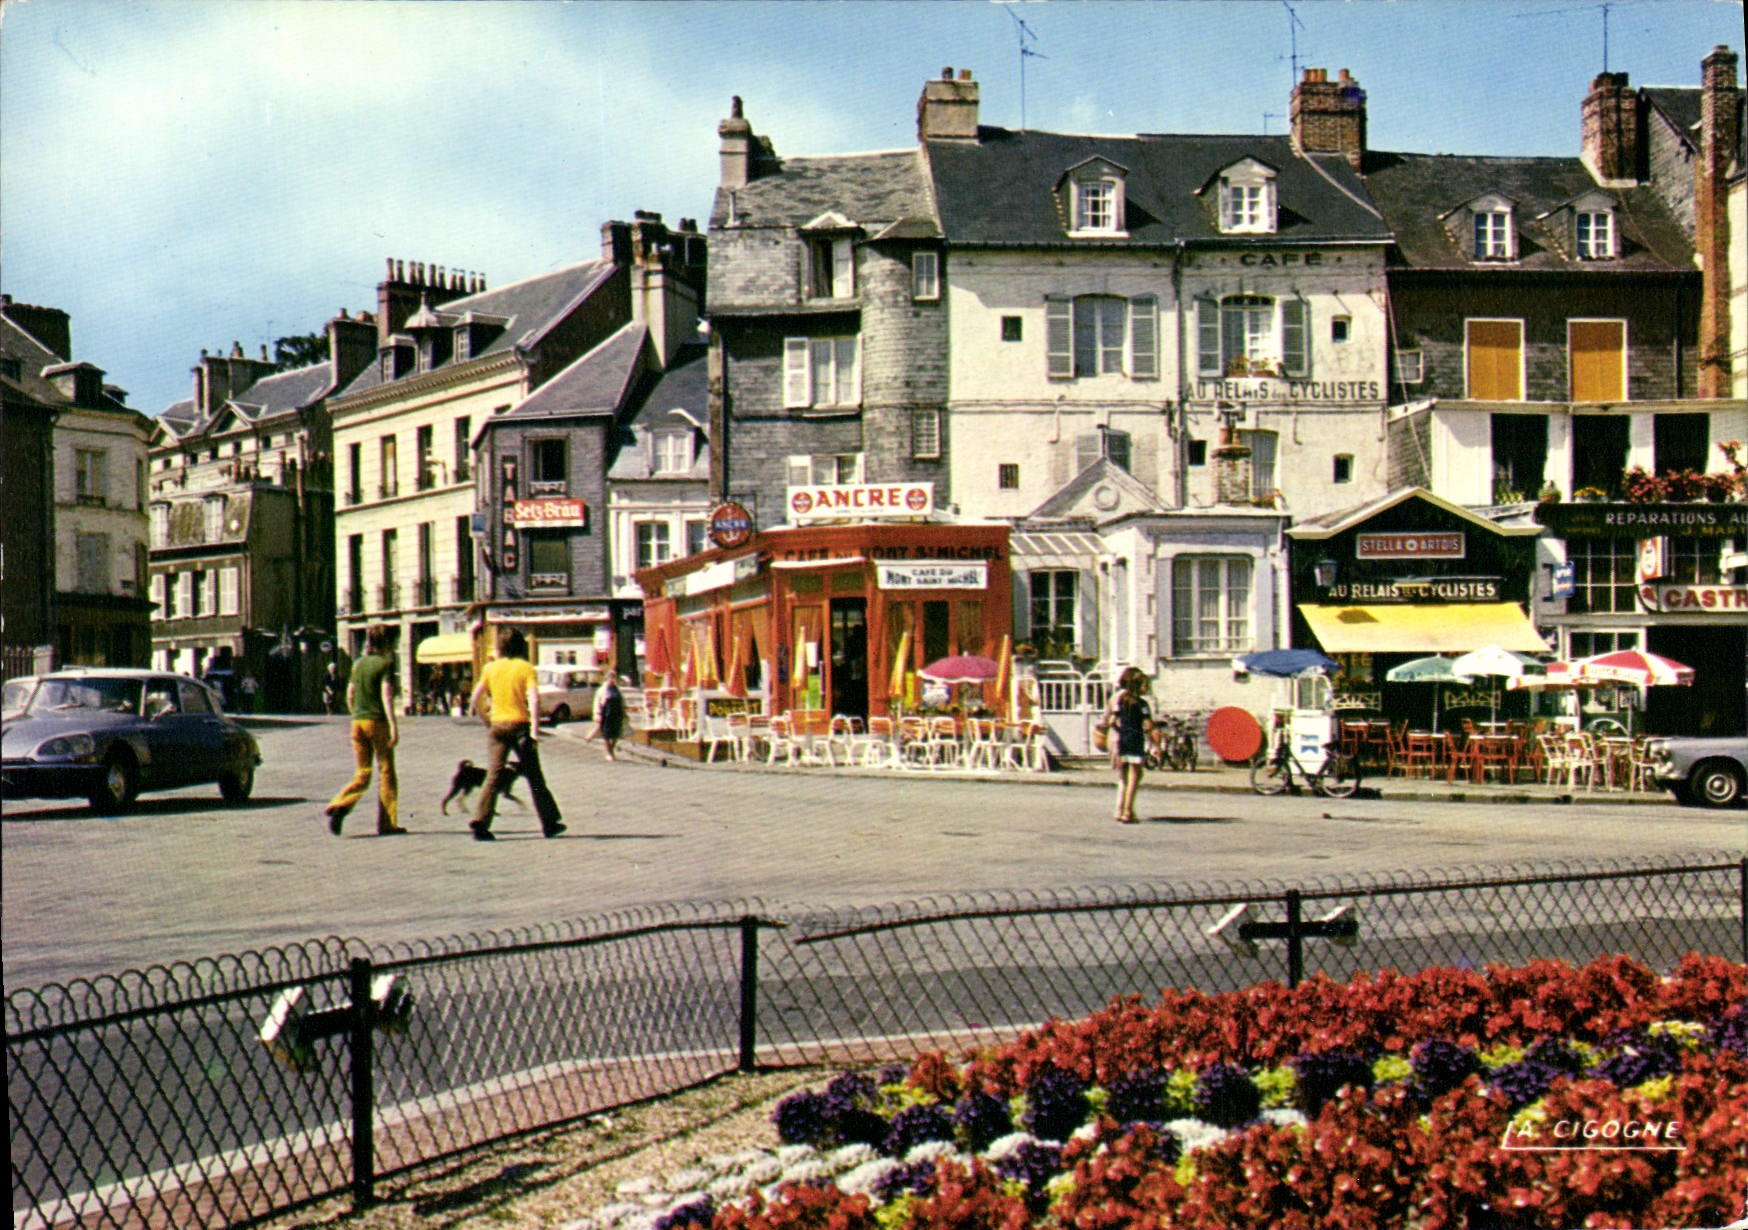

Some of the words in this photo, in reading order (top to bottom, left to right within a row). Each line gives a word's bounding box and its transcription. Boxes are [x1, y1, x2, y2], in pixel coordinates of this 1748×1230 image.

[1240, 253, 1323, 266] CAFE
[1187, 382, 1207, 399] AU
[1289, 381, 1380, 400] CYCLISTES
[814, 487, 903, 508] ANCRE
[503, 463, 517, 569] TABAC
[1605, 512, 1717, 525] REPARATIONS
[1361, 539, 1404, 552] STELLA
[1420, 538, 1460, 551] ARTOIS
[1328, 585, 1349, 598] AU
[1351, 583, 1399, 598] RELAIS
[1418, 582, 1496, 598] CYCLISTES
